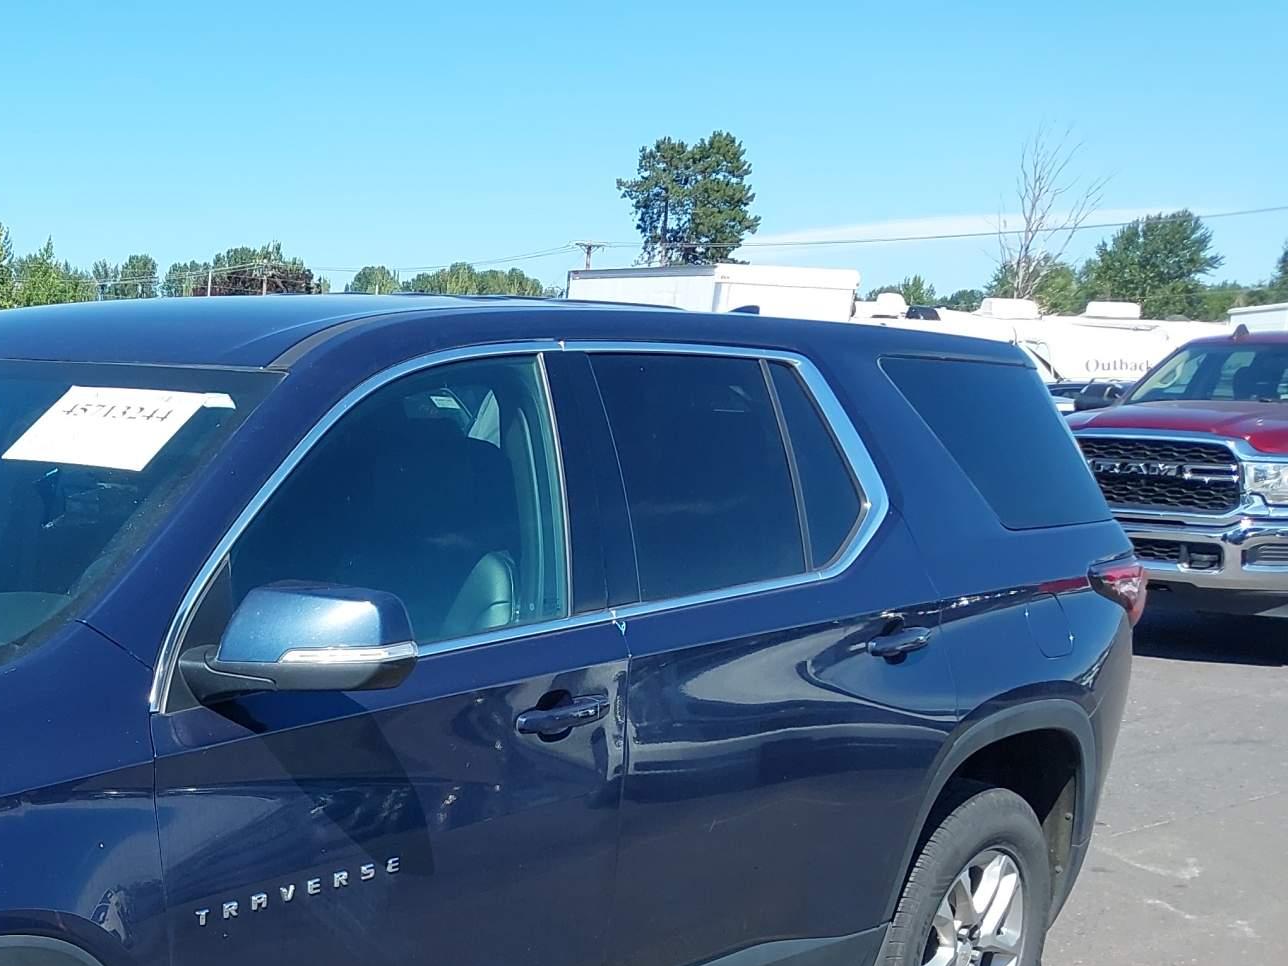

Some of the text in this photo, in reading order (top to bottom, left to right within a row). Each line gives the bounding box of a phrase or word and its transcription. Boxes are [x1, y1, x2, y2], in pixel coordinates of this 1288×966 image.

[62, 403, 174, 422] 45713244
[1094, 461, 1177, 477] RAM
[195, 857, 400, 926] TRAVERSE
